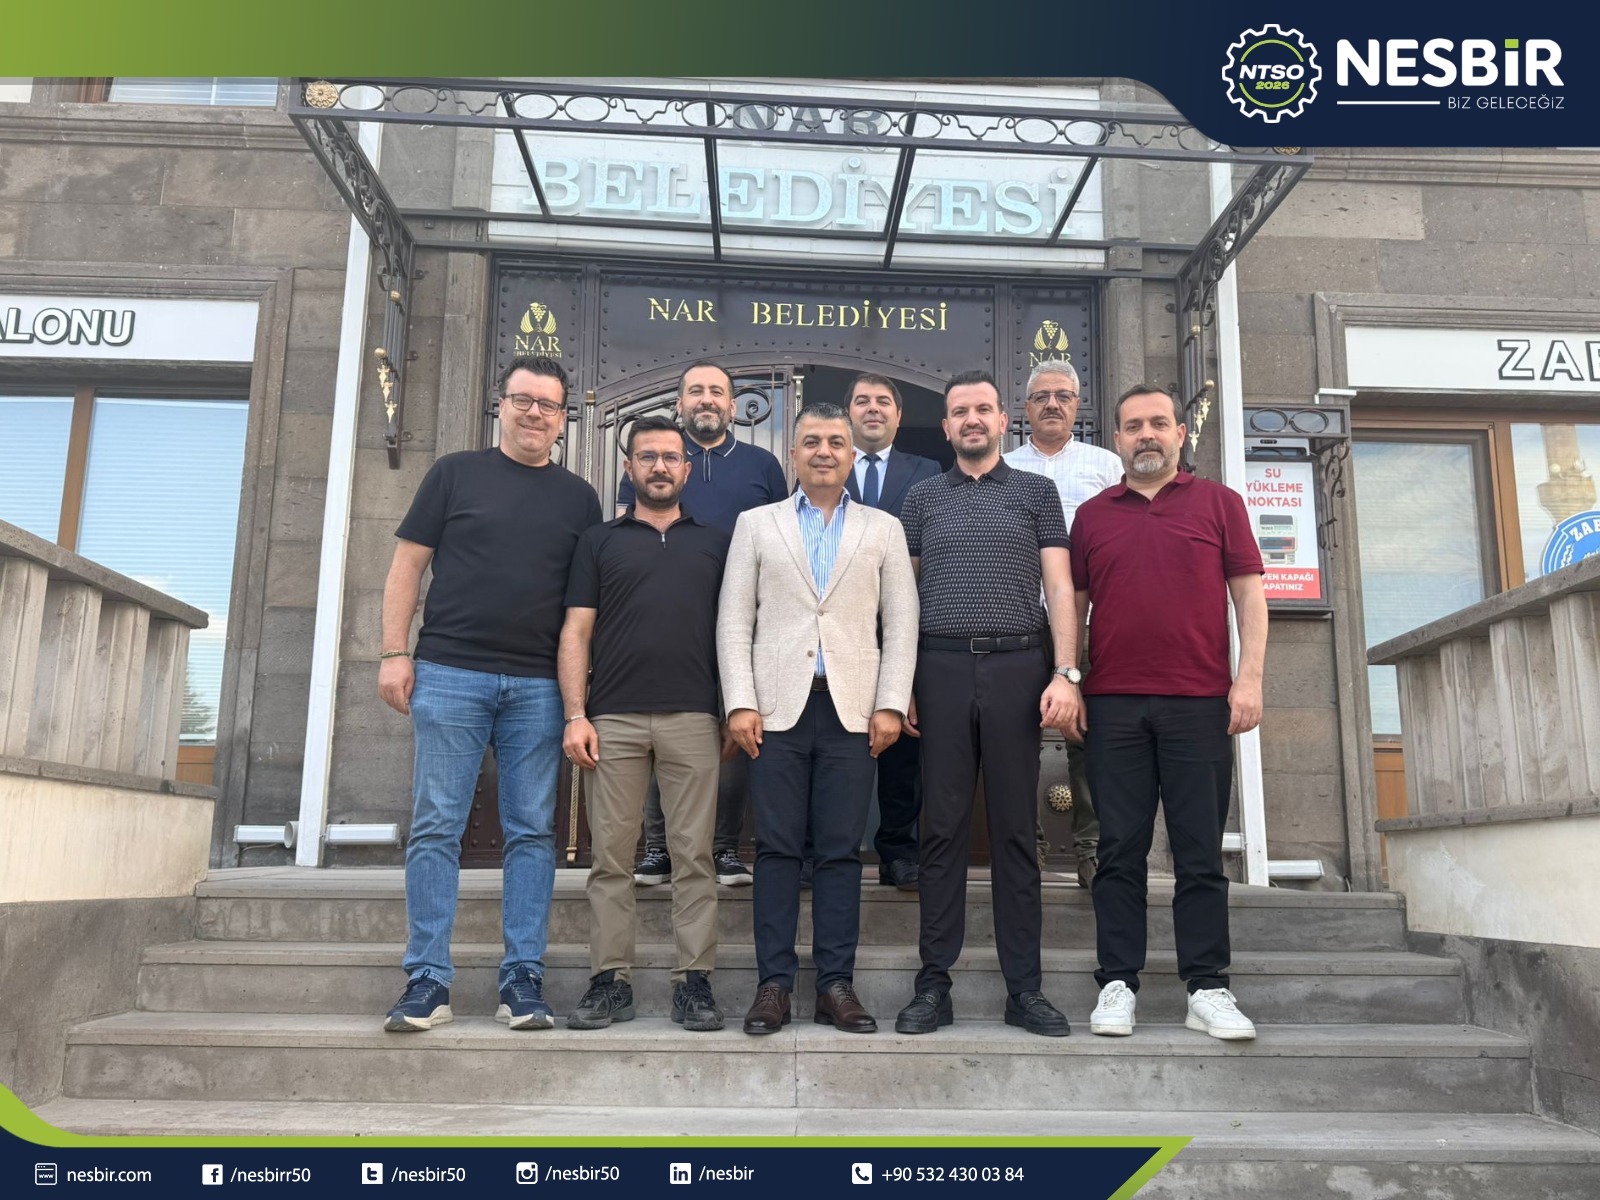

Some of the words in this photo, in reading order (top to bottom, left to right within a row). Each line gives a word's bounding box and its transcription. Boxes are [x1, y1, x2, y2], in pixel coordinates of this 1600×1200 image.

[521, 156, 1077, 236] BELEDİYESİ
[647, 297, 717, 322] NAR
[750, 299, 948, 331] BELEDİYESİ
[0, 306, 136, 347] LONU
[514, 334, 561, 352] NAR
[1264, 467, 1281, 478] SU
[1245, 480, 1304, 493] YÜKLEME
[1263, 583, 1304, 591] APATINIZ
